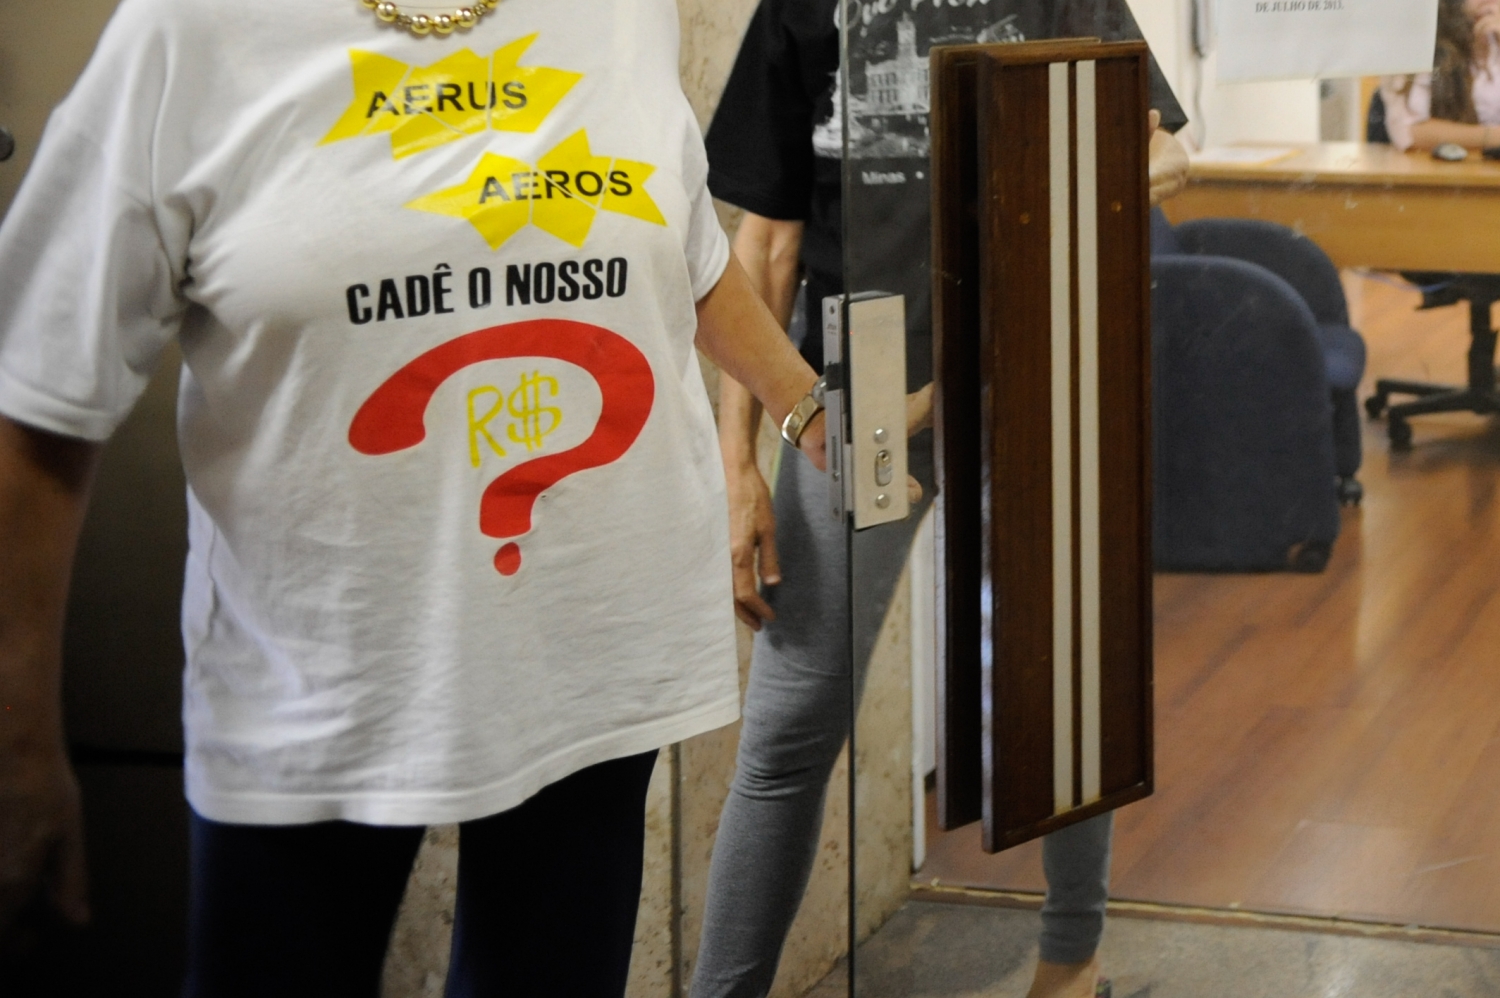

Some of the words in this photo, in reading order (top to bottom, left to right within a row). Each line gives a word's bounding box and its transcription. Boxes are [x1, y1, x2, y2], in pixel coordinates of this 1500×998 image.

[1255, 2, 1270, 13] DE
[1271, 0, 1306, 12] JULHO
[1307, 0, 1322, 11] DE
[365, 79, 529, 120] AERUS
[477, 168, 633, 205] AEROS
[861, 170, 906, 184] Minas
[345, 263, 454, 324] CADÊ
[468, 266, 492, 309] O
[505, 256, 628, 306] NOSSO
[466, 370, 562, 469] R$
